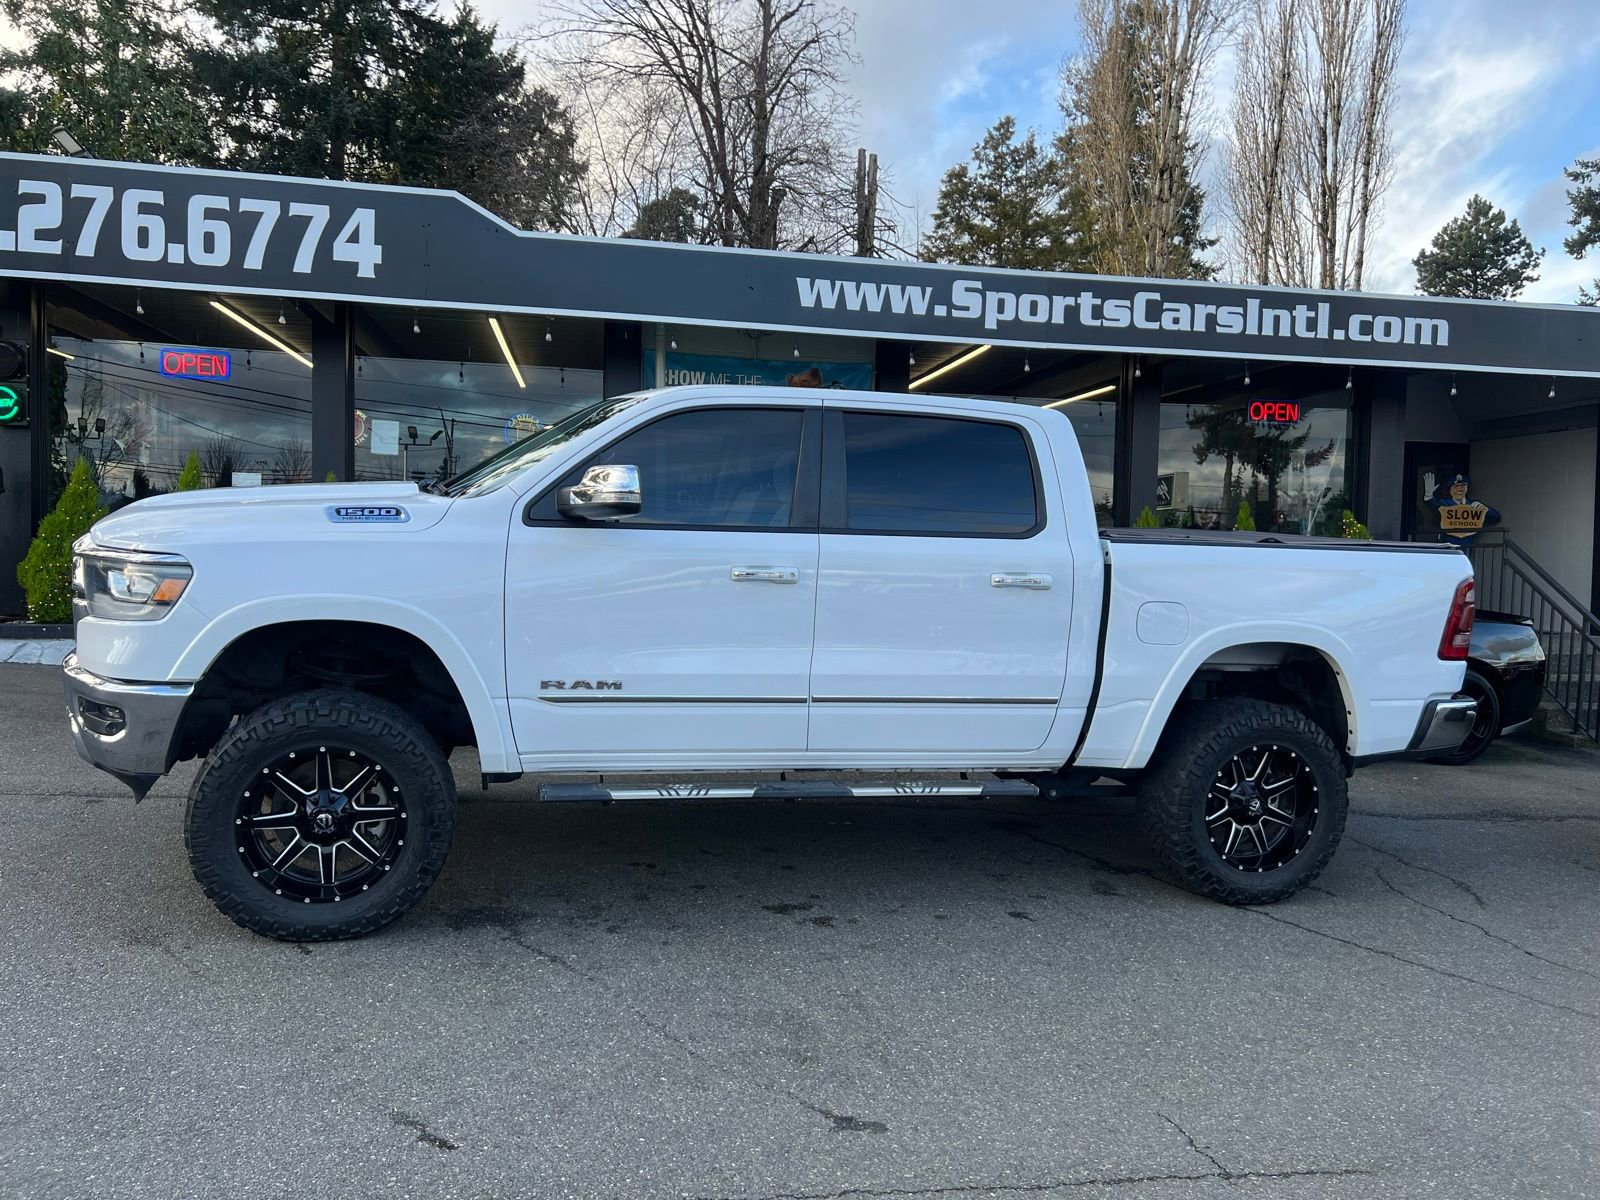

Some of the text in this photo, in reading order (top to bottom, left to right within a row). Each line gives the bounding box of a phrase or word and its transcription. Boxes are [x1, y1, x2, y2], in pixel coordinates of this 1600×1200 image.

[795, 277, 1450, 347] www.SportsCarsIntl.com
[163, 352, 227, 376] OPEN
[710, 372, 731, 385] ME
[736, 374, 762, 386] THE
[1250, 402, 1298, 421] OPEN
[338, 508, 397, 516] 1500
[1446, 509, 1482, 520] SLOW
[540, 680, 622, 690] RAM
